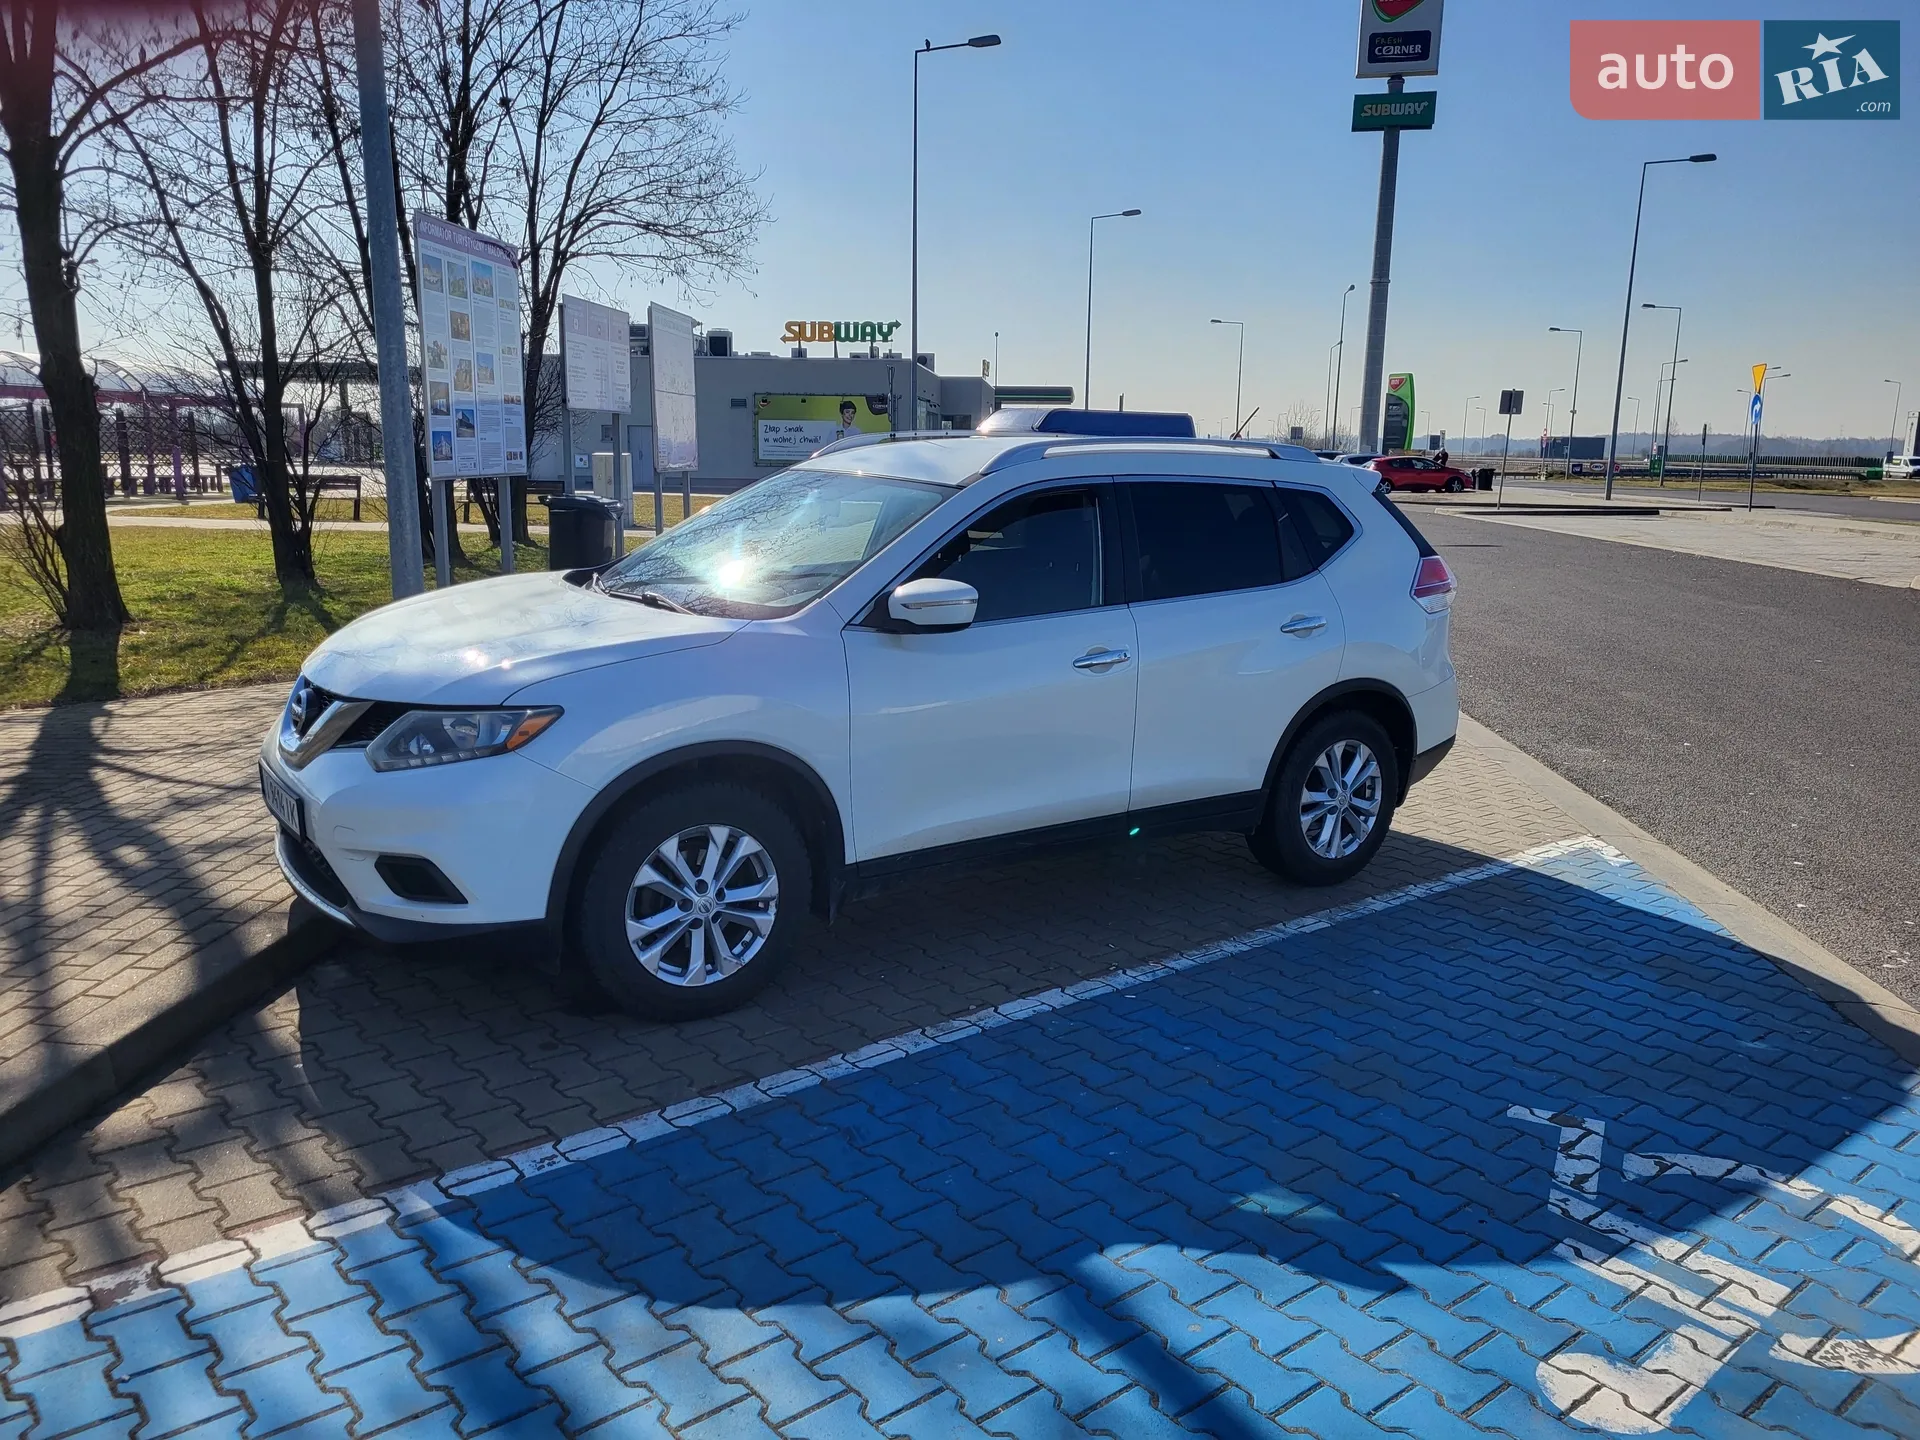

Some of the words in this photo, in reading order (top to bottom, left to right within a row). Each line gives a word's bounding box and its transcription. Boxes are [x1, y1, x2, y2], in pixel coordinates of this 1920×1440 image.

[1375, 37, 1403, 45] FRESH
[1375, 44, 1422, 55] CORNER
[1361, 101, 1428, 117] SUBWAY
[420, 219, 453, 242] INFORMATOR
[780, 319, 902, 343] SUBWAY
[784, 424, 804, 433] smak
[772, 435, 797, 445] wolnej
